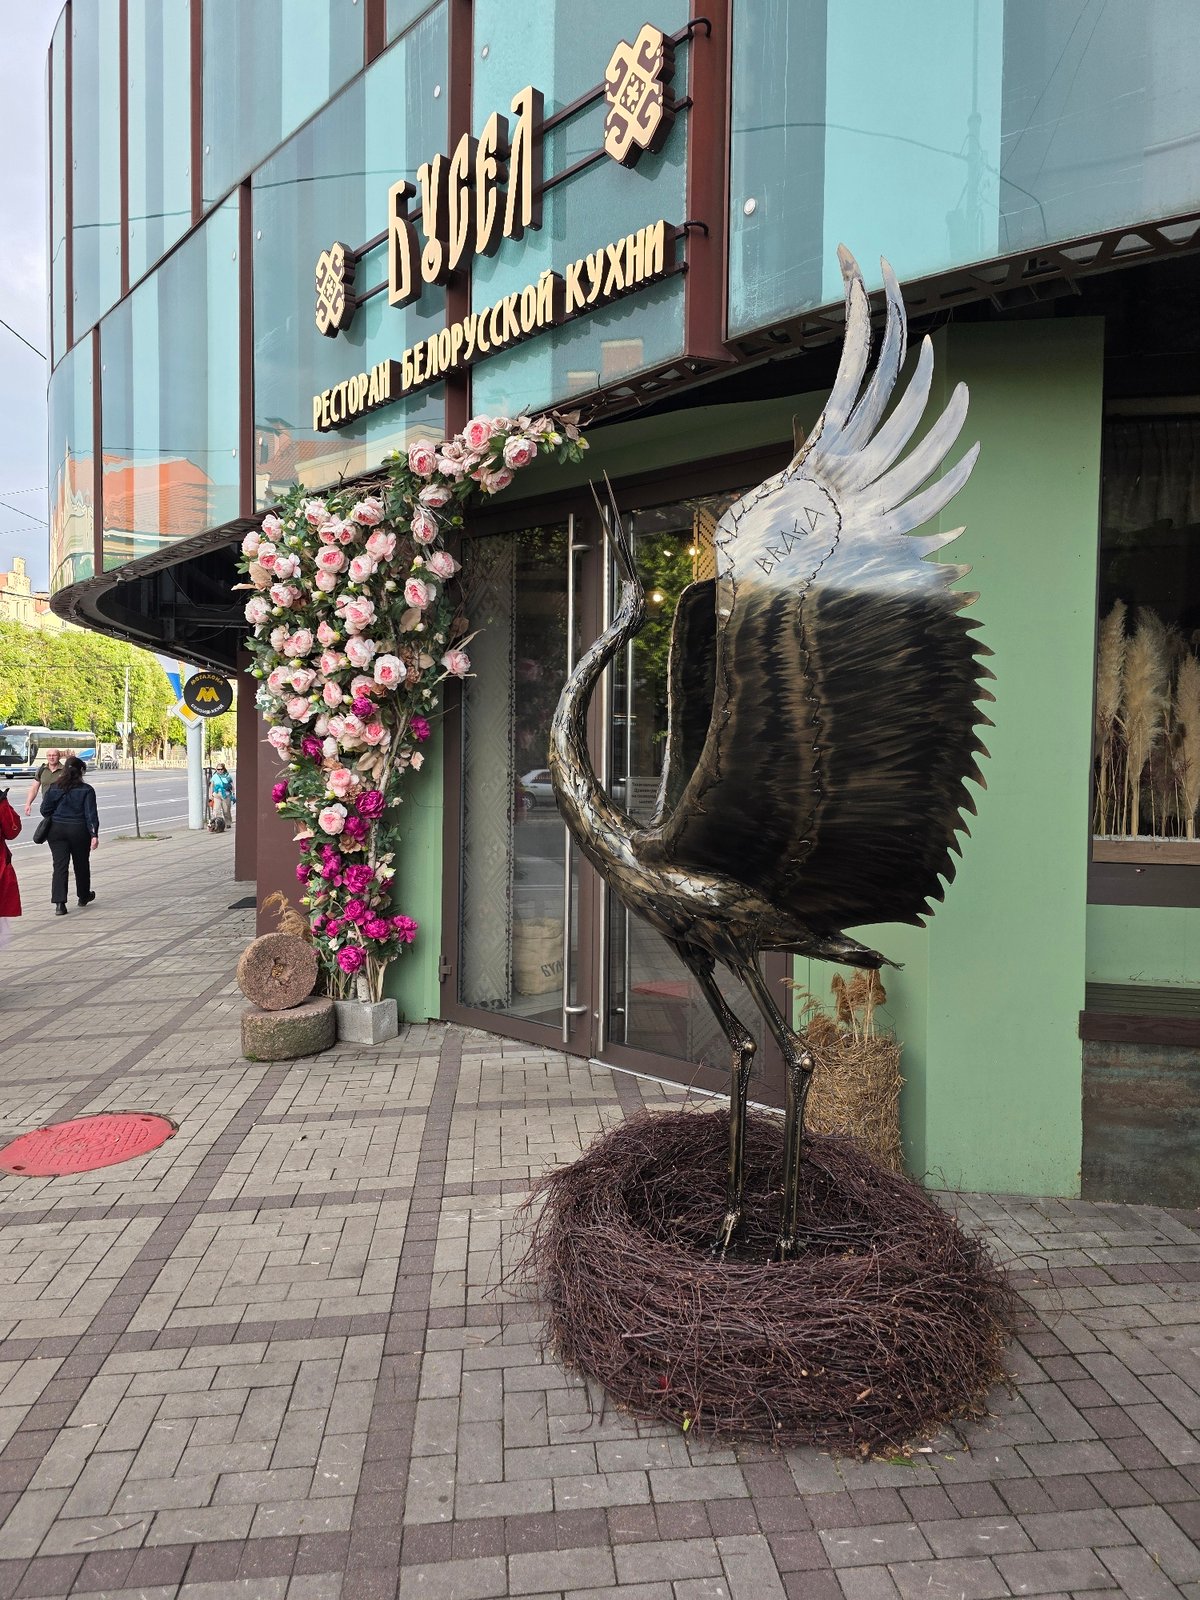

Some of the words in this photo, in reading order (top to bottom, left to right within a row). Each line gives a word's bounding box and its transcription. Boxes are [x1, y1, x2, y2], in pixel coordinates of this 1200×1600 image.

[388, 85, 534, 306] БУСЕЛ
[313, 359, 391, 431] РЕСТОРАН
[401, 269, 554, 391] БЕЛОРУССКОЙ
[565, 219, 665, 313] КУХНИ
